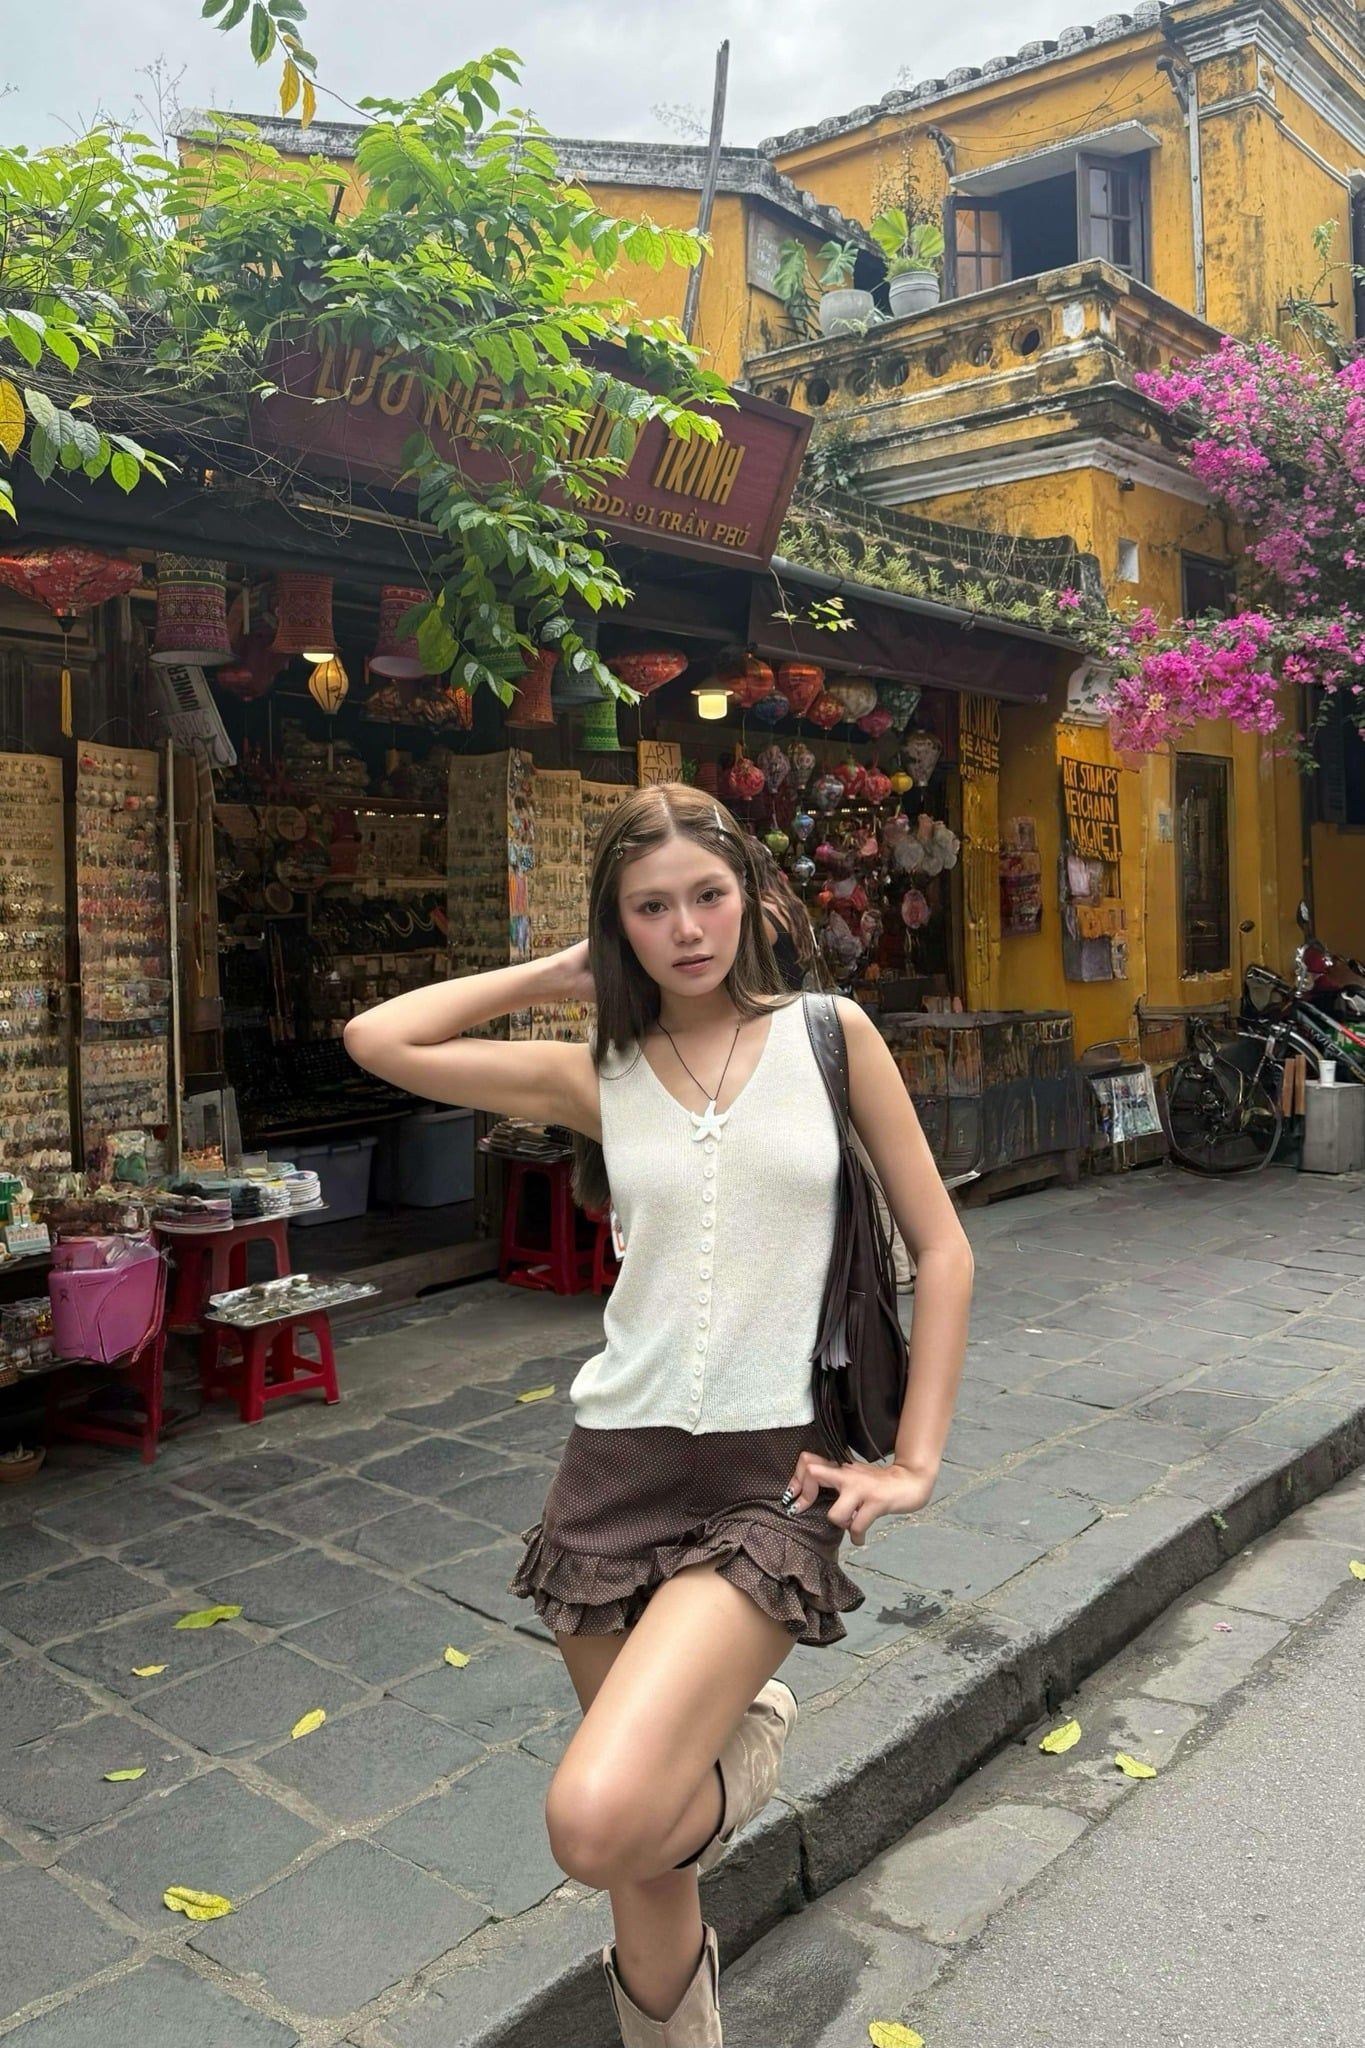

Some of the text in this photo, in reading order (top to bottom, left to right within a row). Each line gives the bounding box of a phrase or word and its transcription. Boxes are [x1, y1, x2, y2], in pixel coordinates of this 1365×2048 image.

[657, 507, 709, 537] TRẦN
[711, 522, 752, 548] PHÚ
[644, 743, 676, 766] ART
[1063, 757, 1118, 795] ART STAMPS
[1064, 787, 1115, 822] KEYCHAIN
[1070, 816, 1119, 854] MAGNET
